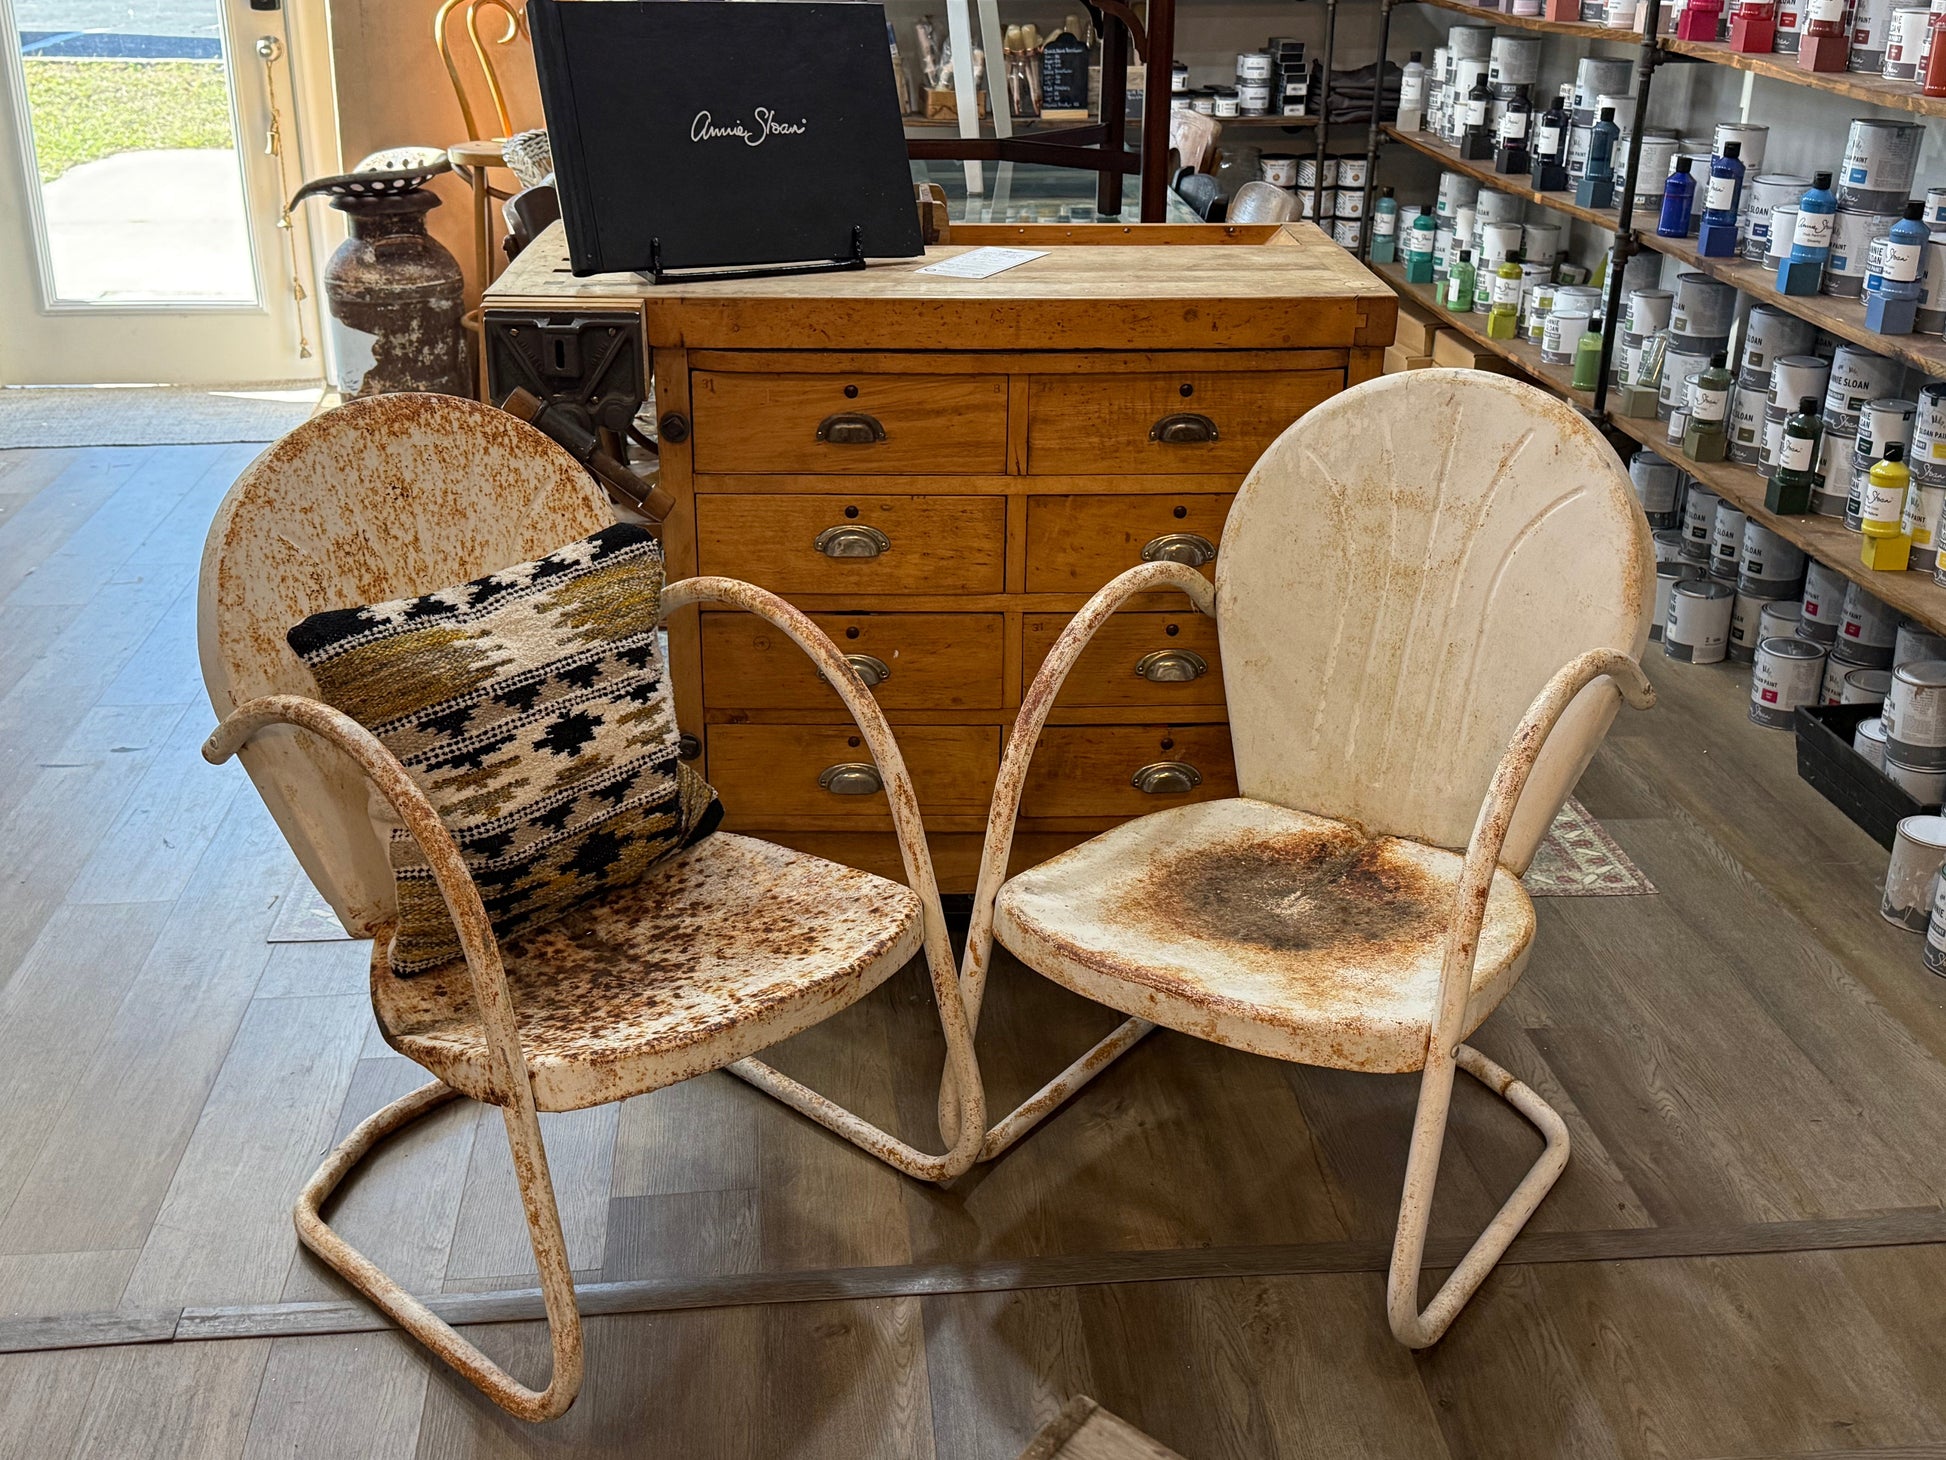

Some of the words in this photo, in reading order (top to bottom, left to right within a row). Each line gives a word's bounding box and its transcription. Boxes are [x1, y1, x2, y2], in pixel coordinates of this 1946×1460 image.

[690, 110, 748, 142] Annie
[744, 106, 807, 147] Sloan
[1749, 204, 1769, 216] SLOAN
[1843, 377, 1870, 391] SLOAN
[1735, 410, 1754, 422] SLOAN
[1688, 510, 1706, 522] SLOAN
[1911, 514, 1925, 523] PAINT
[1716, 528, 1735, 539] SLOAN
[1745, 544, 1762, 557] SLOAN
[1848, 612, 1862, 620] PAINT
[1763, 680, 1778, 688] PAINT
